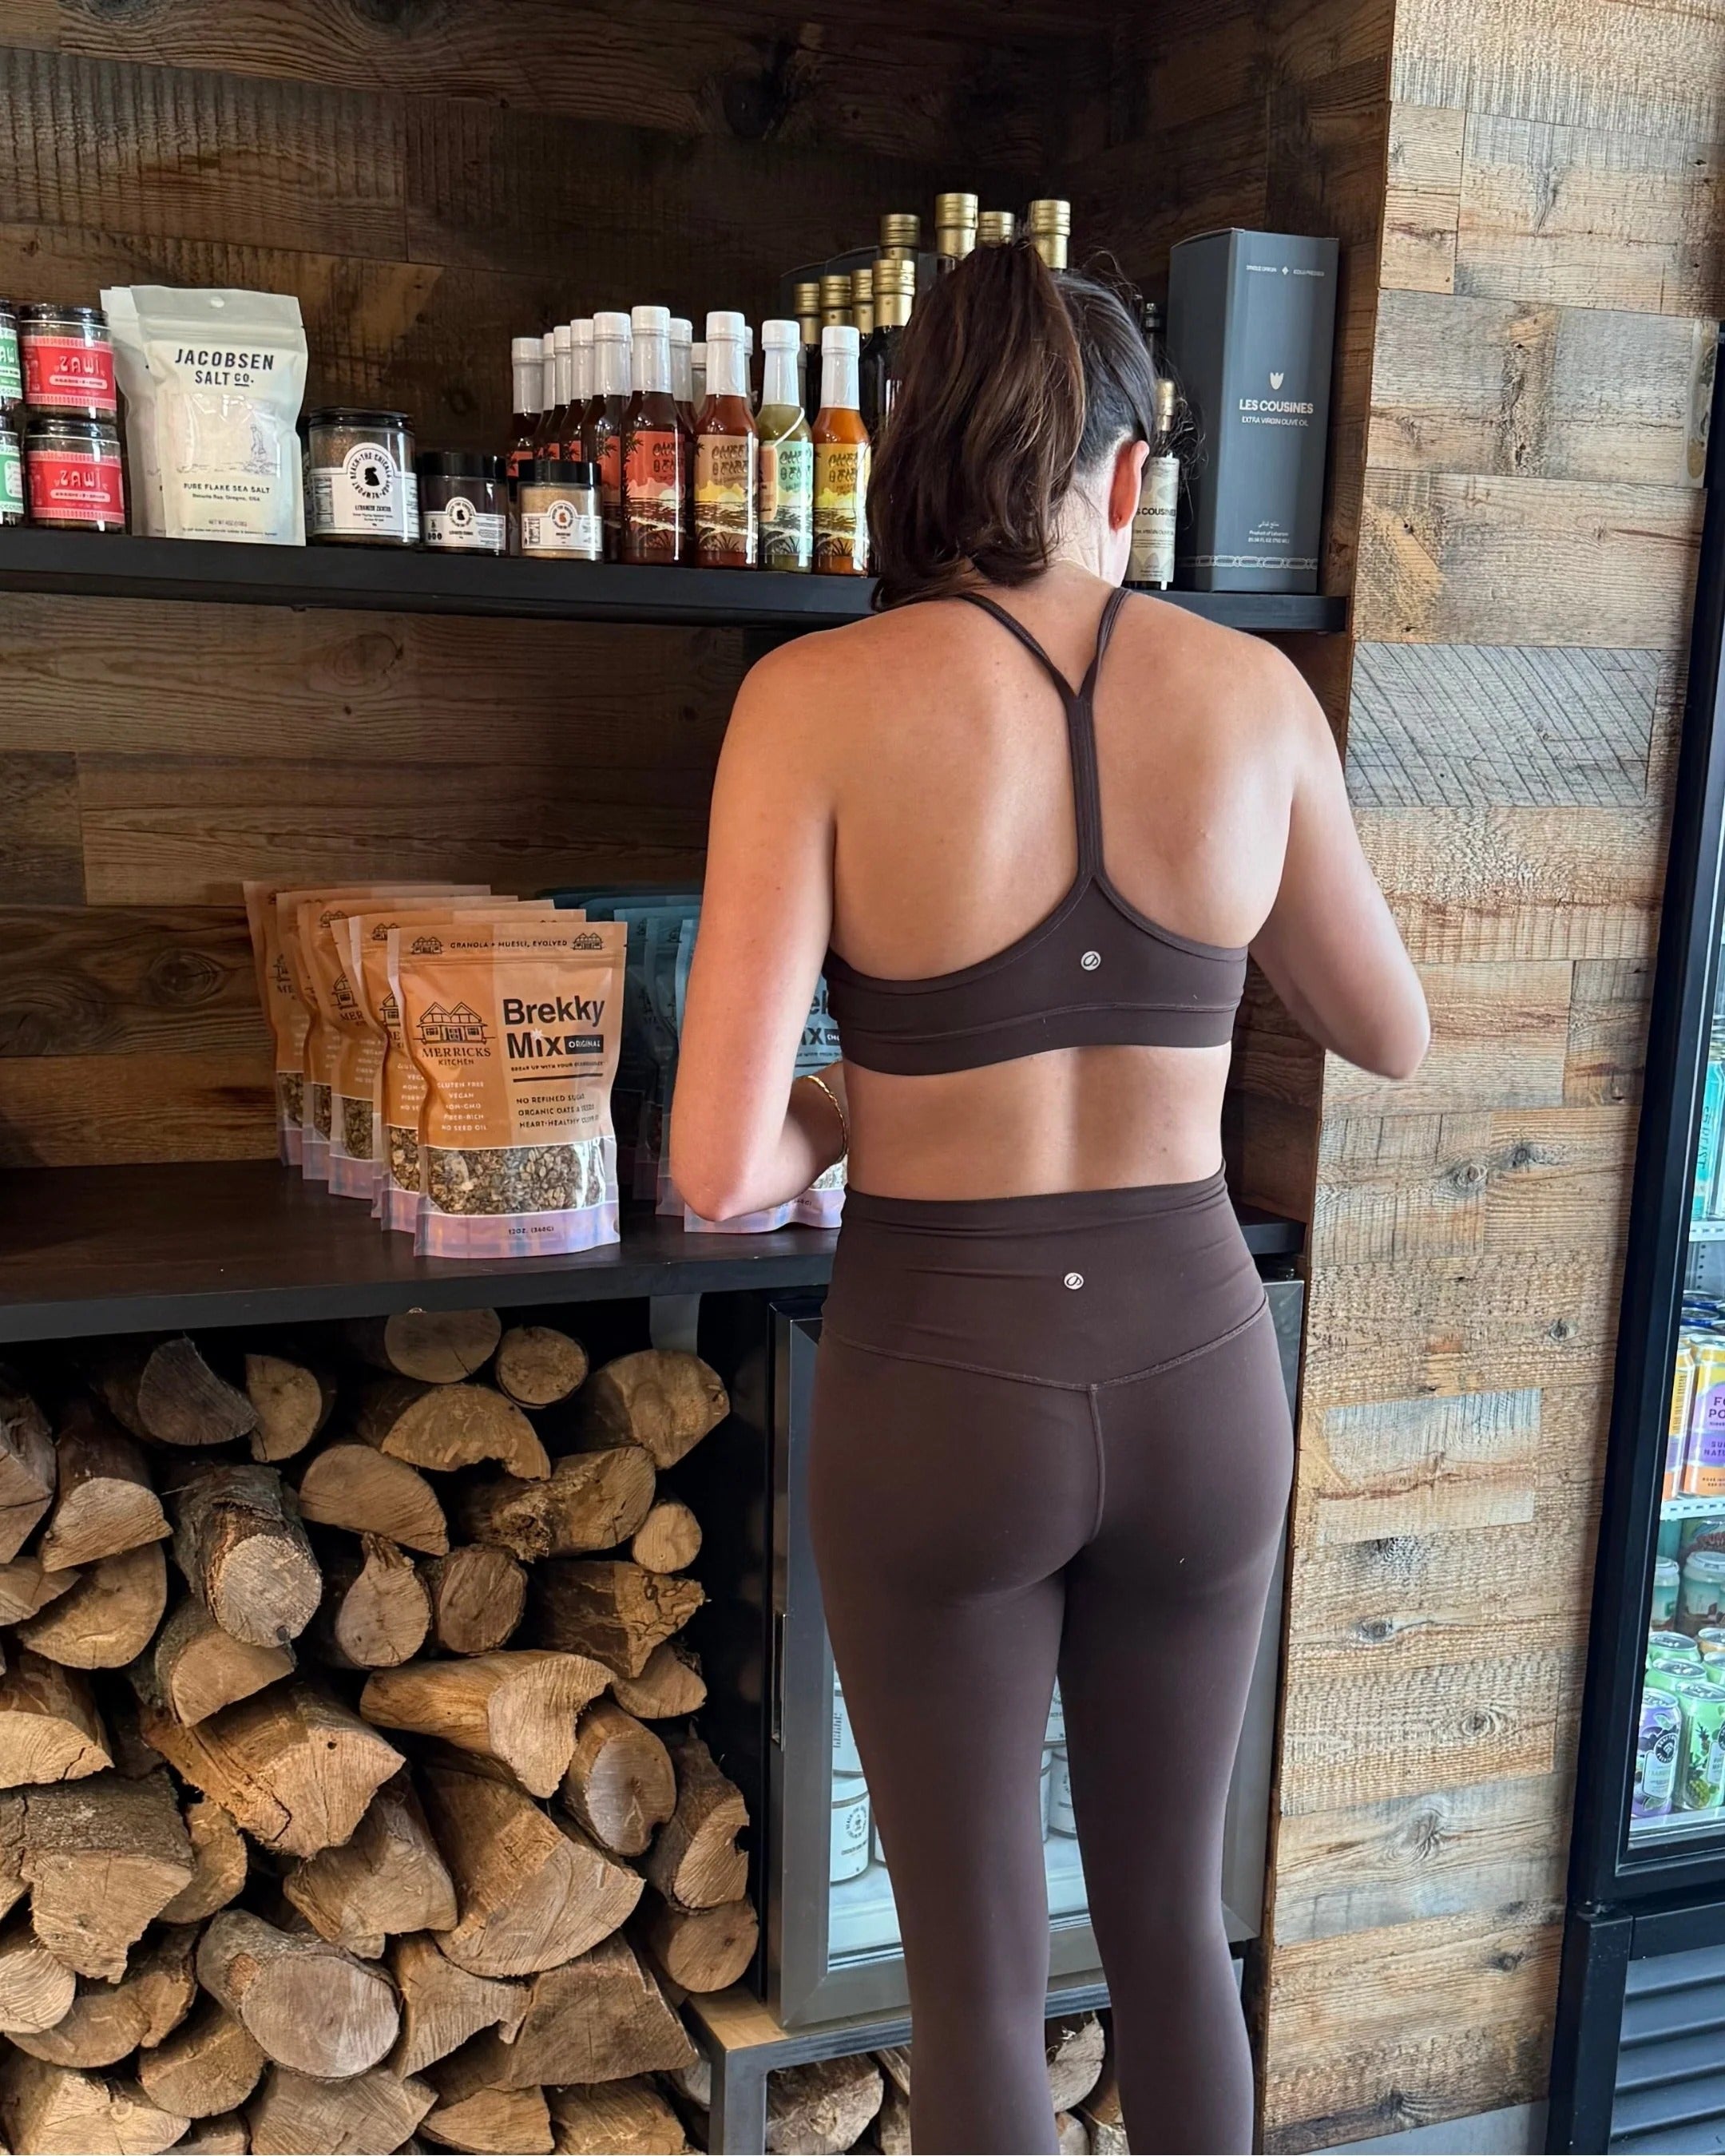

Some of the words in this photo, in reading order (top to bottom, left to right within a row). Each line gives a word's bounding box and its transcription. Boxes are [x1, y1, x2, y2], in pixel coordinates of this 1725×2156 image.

[175, 348, 275, 371] JACOBSEN
[195, 370, 231, 386] SALT
[234, 373, 254, 385] CO.
[1239, 398, 1259, 412] LES
[1259, 399, 1315, 415] COUSINES
[1261, 417, 1280, 426] VIRGIN
[502, 994, 605, 1028] Brekky
[421, 1046, 491, 1058] MERRICKS
[506, 1028, 564, 1060] Mix
[568, 1040, 601, 1049] ORIGINAL
[438, 1057, 474, 1067] KITCHEN
[518, 1108, 553, 1116] ORGANIC
